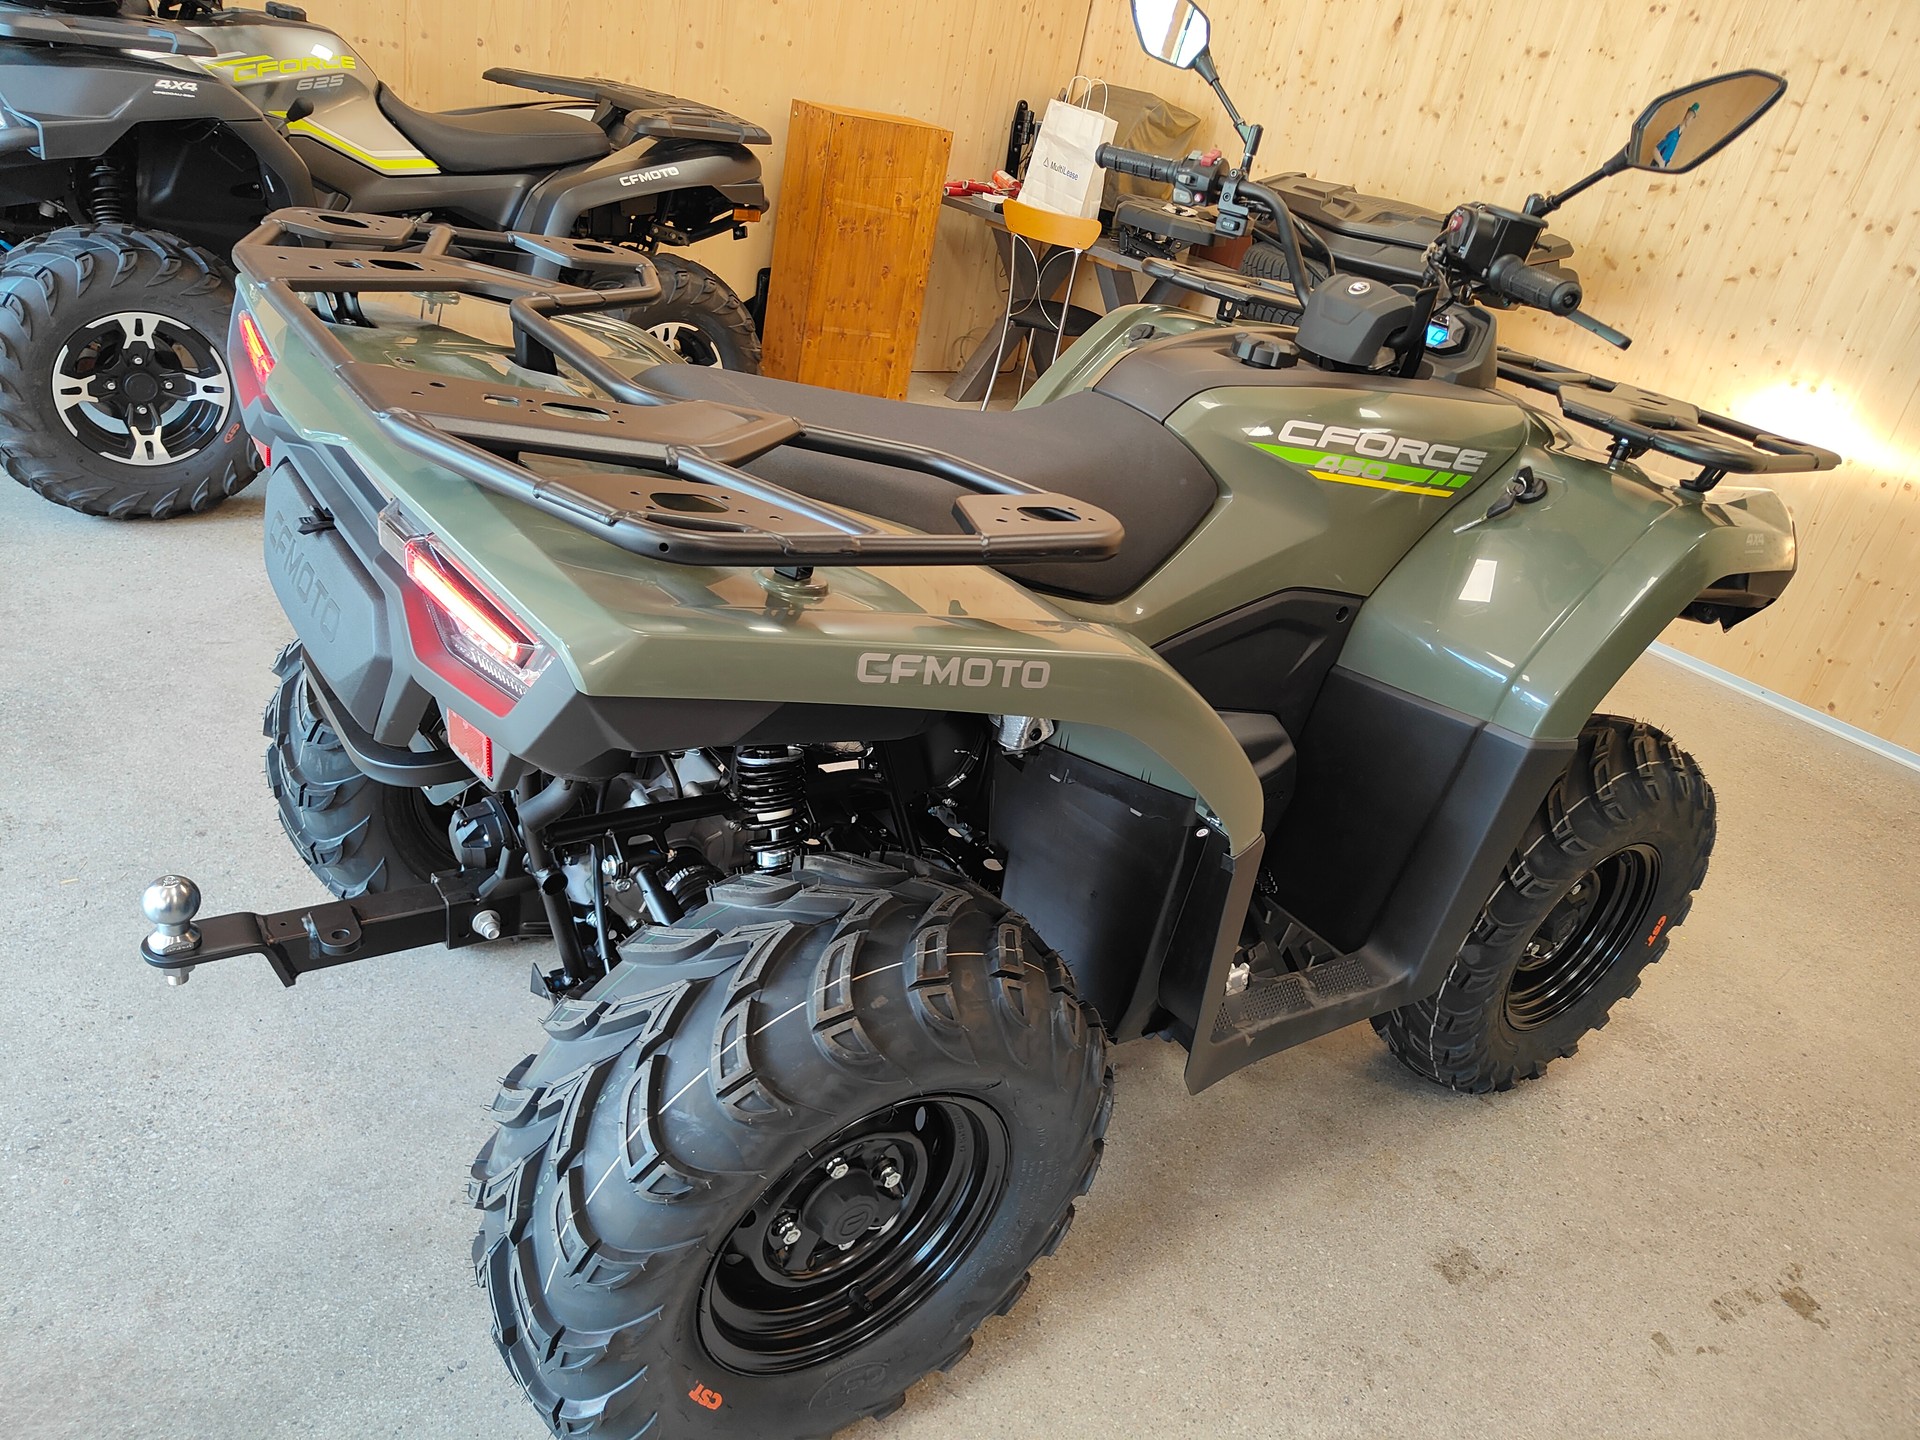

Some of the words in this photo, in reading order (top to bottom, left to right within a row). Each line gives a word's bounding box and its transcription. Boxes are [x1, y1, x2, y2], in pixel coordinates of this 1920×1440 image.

[233, 56, 356, 82] CFORCE
[296, 74, 345, 91] 625
[619, 166, 680, 187] CFMOTO
[1049, 161, 1079, 181] MultiLease
[1278, 420, 1488, 473] CFORCE
[1314, 455, 1389, 481] 450
[269, 509, 342, 644] CFMOTO
[857, 652, 1051, 690] CFMOTO
[1646, 915, 1667, 947] CST
[688, 1380, 723, 1410] CST
